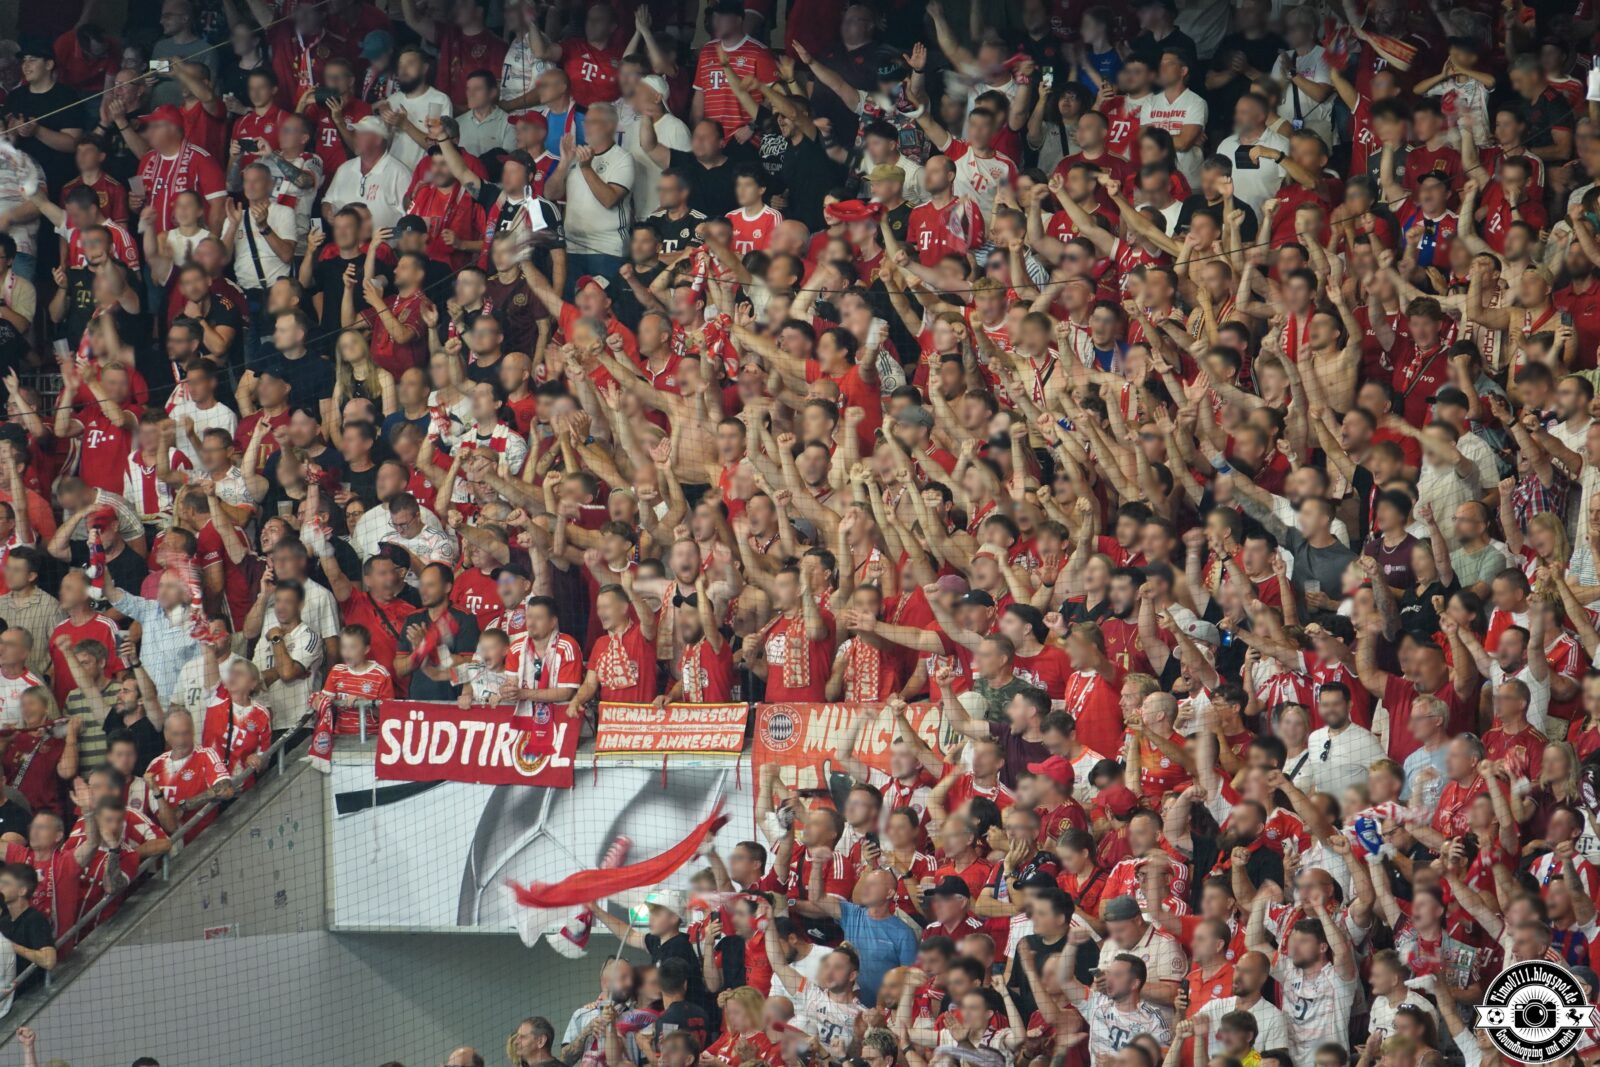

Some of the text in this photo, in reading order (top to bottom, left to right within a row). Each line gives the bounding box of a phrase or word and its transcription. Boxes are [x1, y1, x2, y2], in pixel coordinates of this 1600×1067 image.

[581, 62, 598, 82] T
[710, 71, 723, 90] T
[322, 128, 337, 147] T
[1109, 121, 1131, 143] T
[920, 231, 932, 250] T
[87, 430, 104, 448] T
[466, 596, 483, 614] T
[188, 688, 200, 705] T
[602, 707, 746, 723] NIEMALS ABWESEND
[803, 704, 938, 755] MUIC'S
[380, 710, 570, 776] SÜDTIROL
[599, 733, 741, 749] IMMER ANWESEND
[1579, 836, 1593, 855] T
[1109, 1025, 1130, 1051] T
